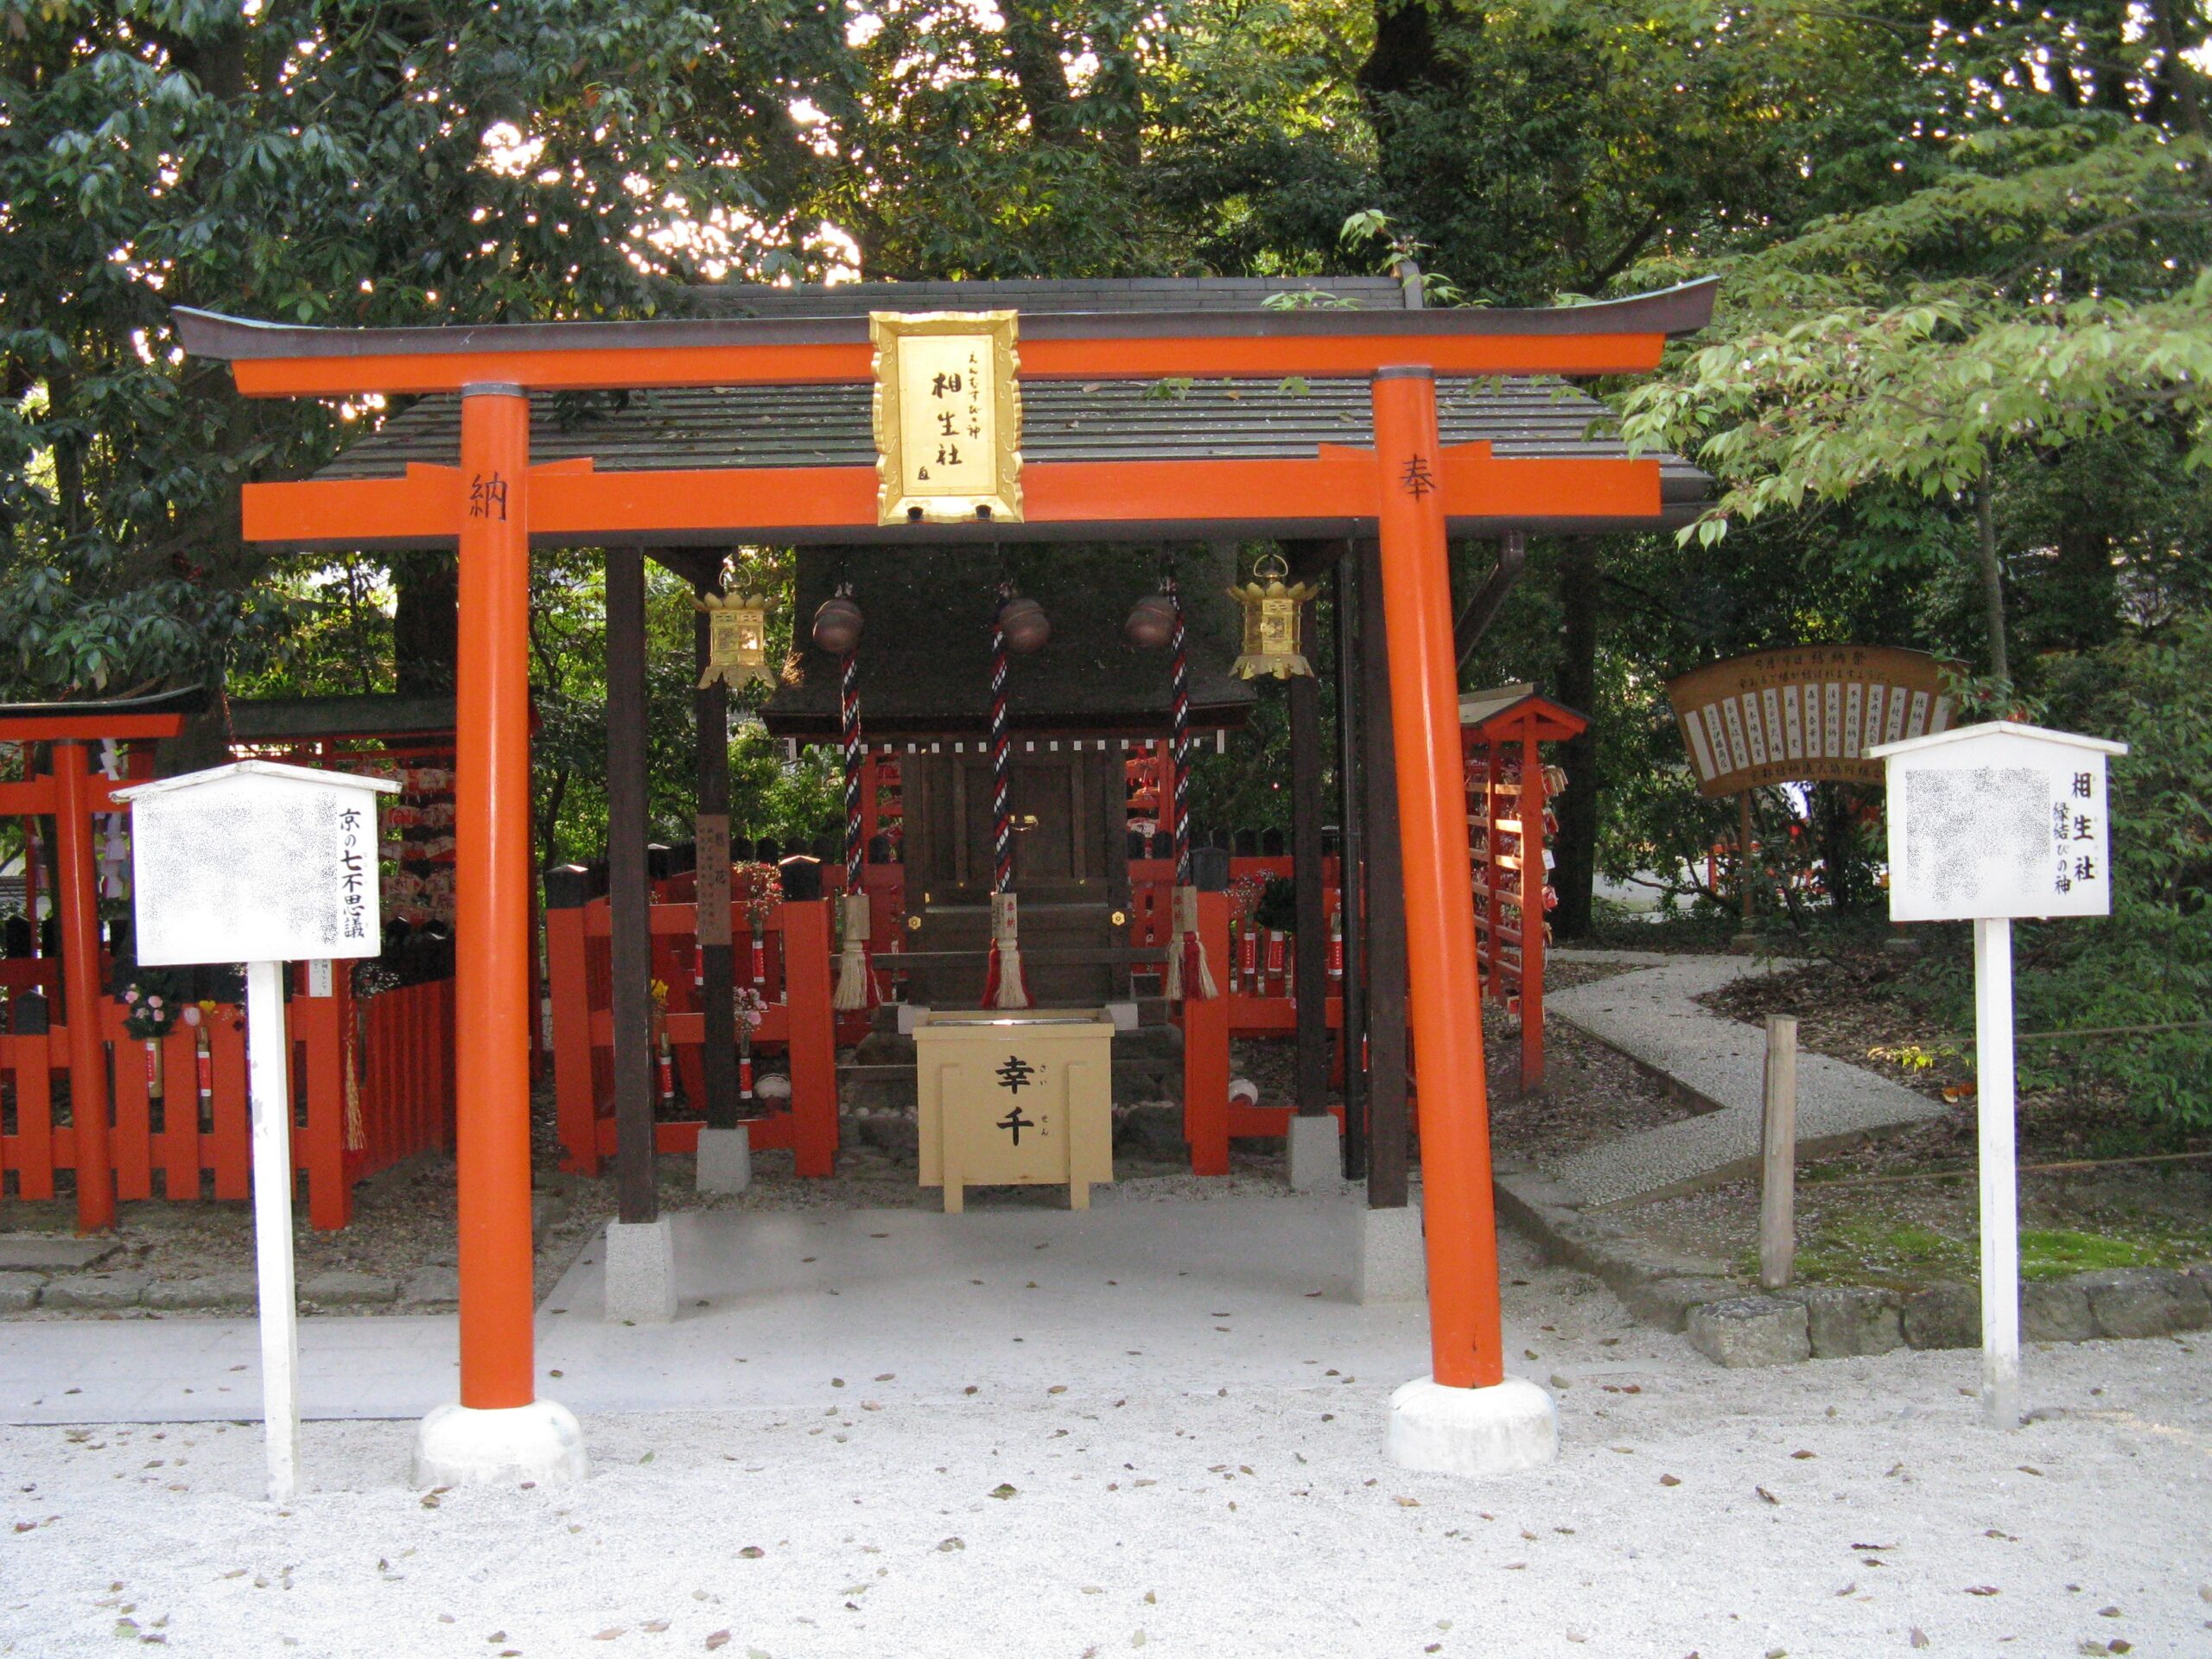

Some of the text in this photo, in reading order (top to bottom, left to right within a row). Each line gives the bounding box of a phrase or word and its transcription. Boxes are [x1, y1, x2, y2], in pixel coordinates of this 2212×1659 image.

[931, 372, 963, 466] 相生社
[966, 351, 982, 440] えんむすびの神
[469, 471, 507, 522] 納
[1399, 453, 1438, 502] 奉
[2053, 802, 2071, 895] 縁結びの神
[2071, 772, 2095, 881] 相生社
[339, 808, 365, 938] 京の七不思議
[995, 1055, 1035, 1147] 幸千
